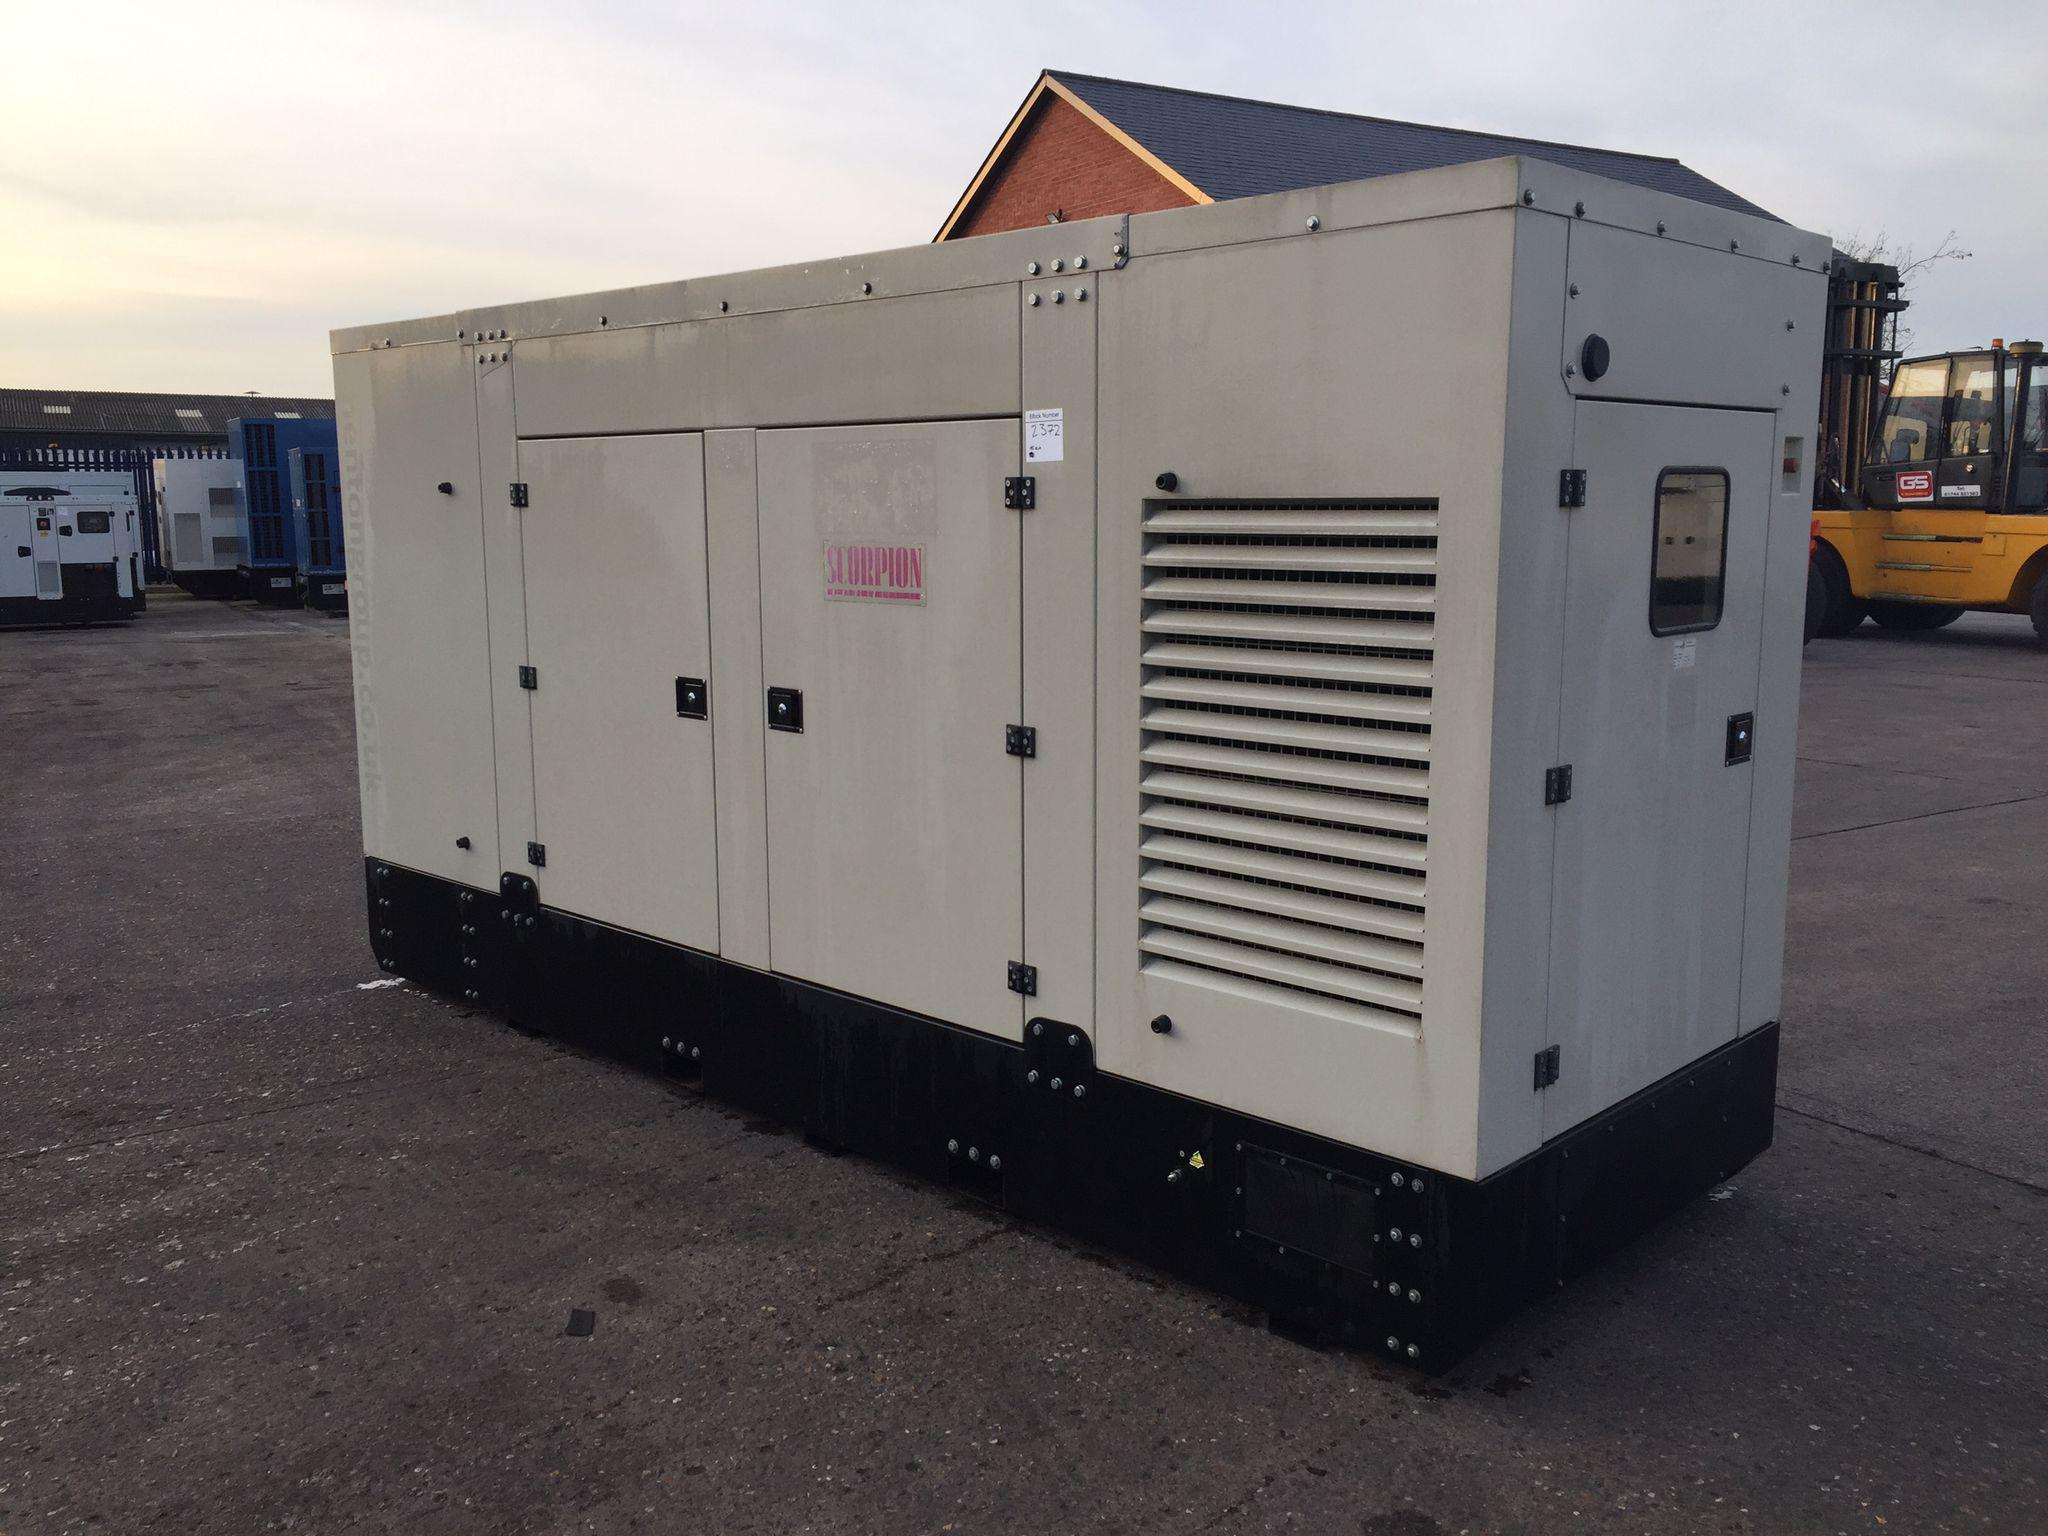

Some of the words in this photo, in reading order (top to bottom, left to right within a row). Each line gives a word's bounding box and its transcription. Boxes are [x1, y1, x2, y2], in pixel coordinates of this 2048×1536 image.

[1031, 423, 1060, 438] 2372
[1900, 475, 1929, 490] GS
[827, 546, 922, 588] SCORPION
